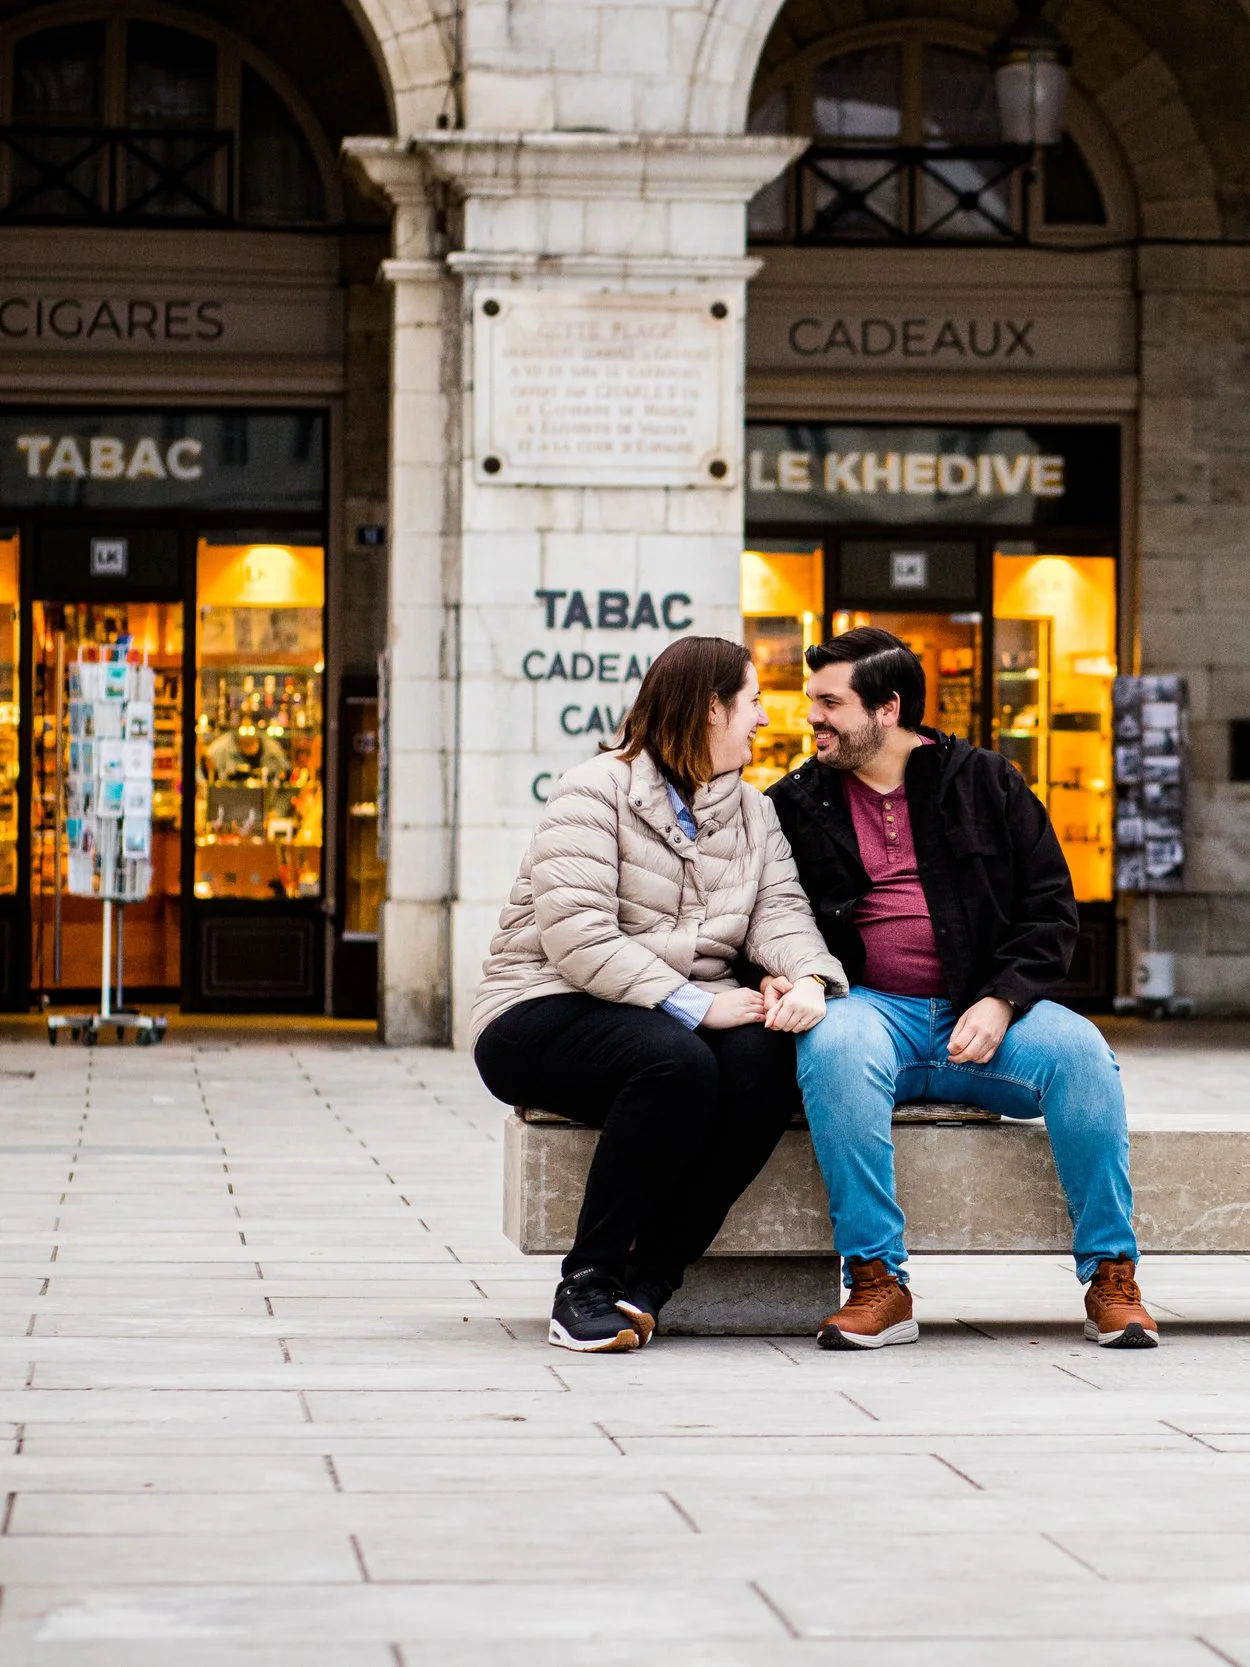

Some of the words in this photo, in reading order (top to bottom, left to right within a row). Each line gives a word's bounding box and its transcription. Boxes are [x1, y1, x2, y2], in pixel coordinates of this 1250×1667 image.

[0, 298, 225, 341] CIGARES
[788, 317, 1035, 358] CADEAUX
[16, 434, 204, 481] TABAC
[749, 450, 811, 492] LE
[824, 451, 1066, 497] KHEDIVE
[535, 590, 694, 631] TABAC
[522, 650, 653, 682] CADEA
[560, 705, 628, 735] CAV
